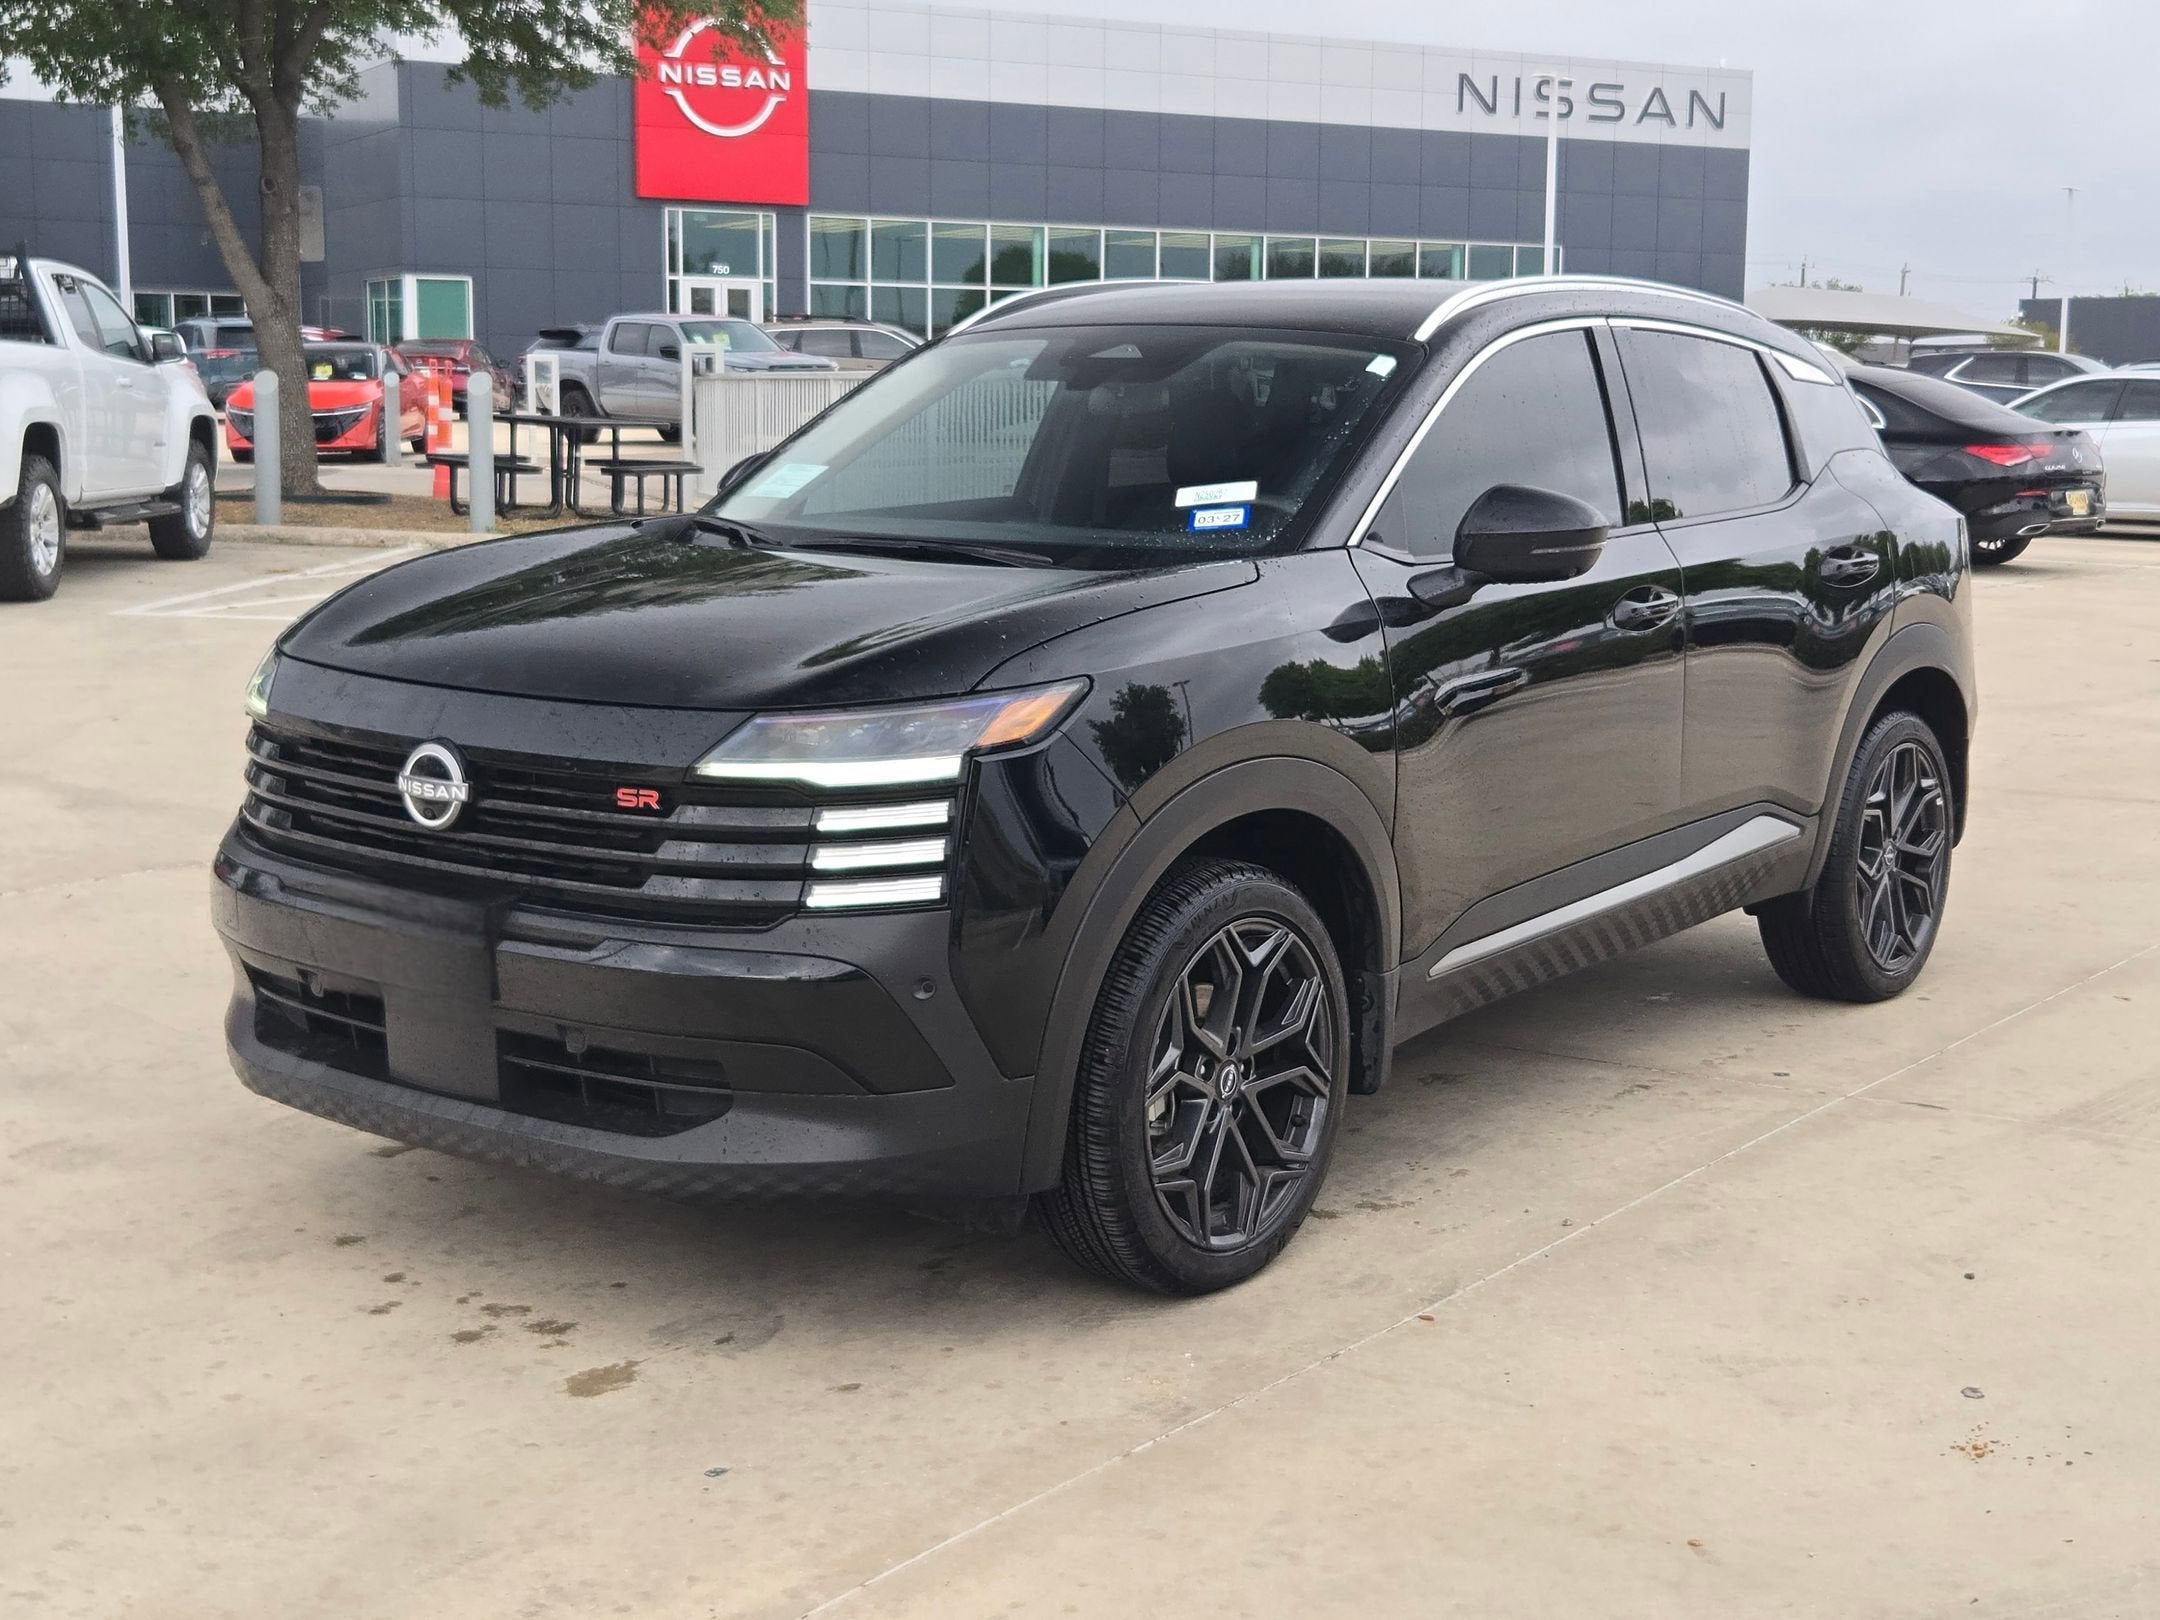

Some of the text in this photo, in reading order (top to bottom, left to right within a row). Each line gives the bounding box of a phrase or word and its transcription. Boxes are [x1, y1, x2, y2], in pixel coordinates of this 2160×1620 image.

[659, 63, 790, 91] NISSAN
[1456, 73, 1726, 130] NISSAN
[712, 265, 730, 275] 750
[398, 775, 466, 800] NISSAN
[617, 788, 660, 810] SR
